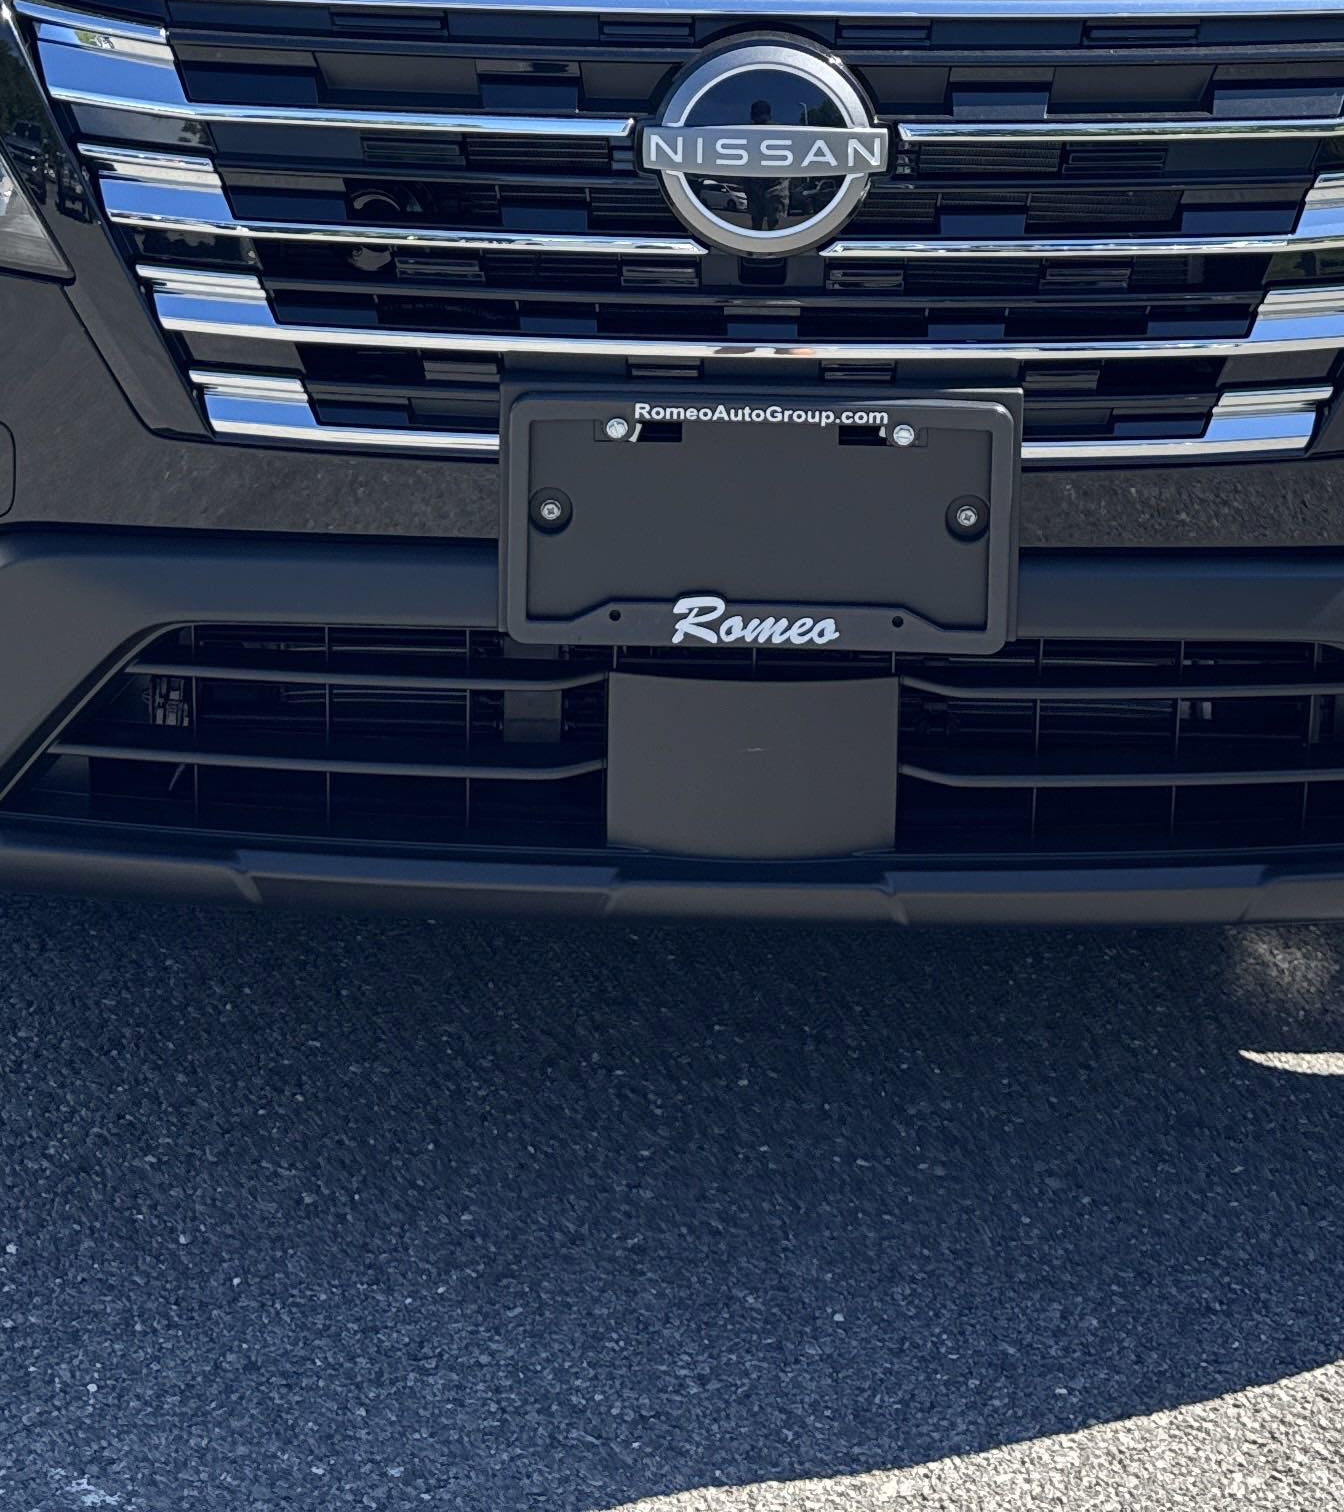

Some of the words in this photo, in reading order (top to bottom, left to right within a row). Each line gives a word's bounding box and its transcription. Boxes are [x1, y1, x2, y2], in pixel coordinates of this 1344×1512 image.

[650, 134, 881, 167] NISSAN
[634, 403, 888, 426] RomeoAutoGroup.com
[671, 596, 840, 644] Romeo
